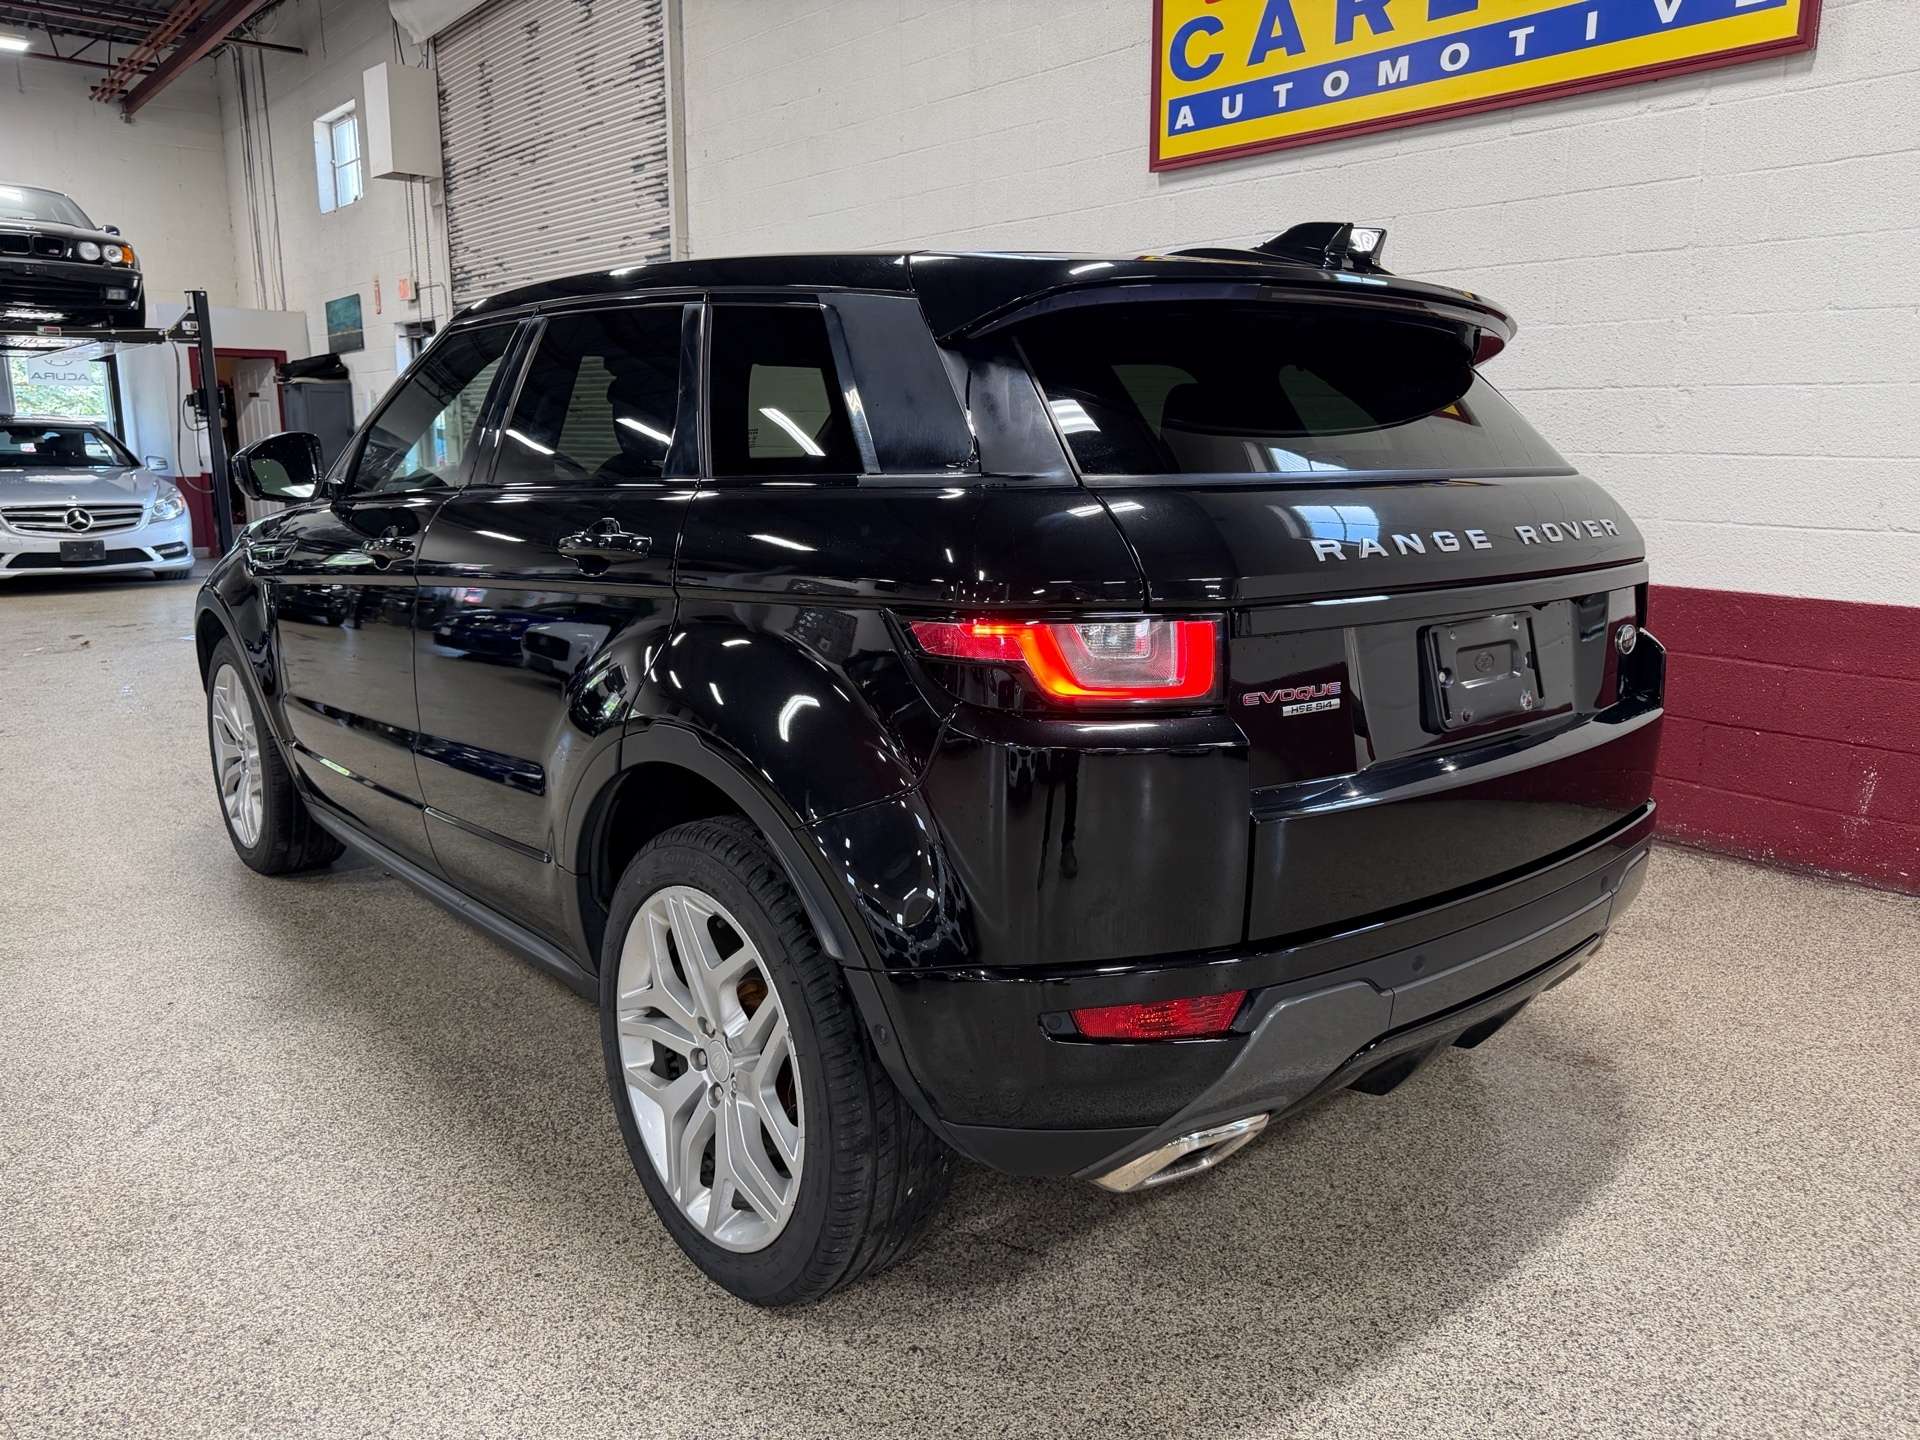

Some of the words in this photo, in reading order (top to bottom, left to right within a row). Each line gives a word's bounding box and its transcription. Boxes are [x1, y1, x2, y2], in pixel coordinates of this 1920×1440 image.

[1174, 0, 1767, 130] AUTOMOTIV
[1310, 529, 1492, 562] RANGE
[1514, 518, 1620, 544] ROVER
[1243, 681, 1341, 706] EVOQUE
[1291, 704, 1313, 713] HSE
